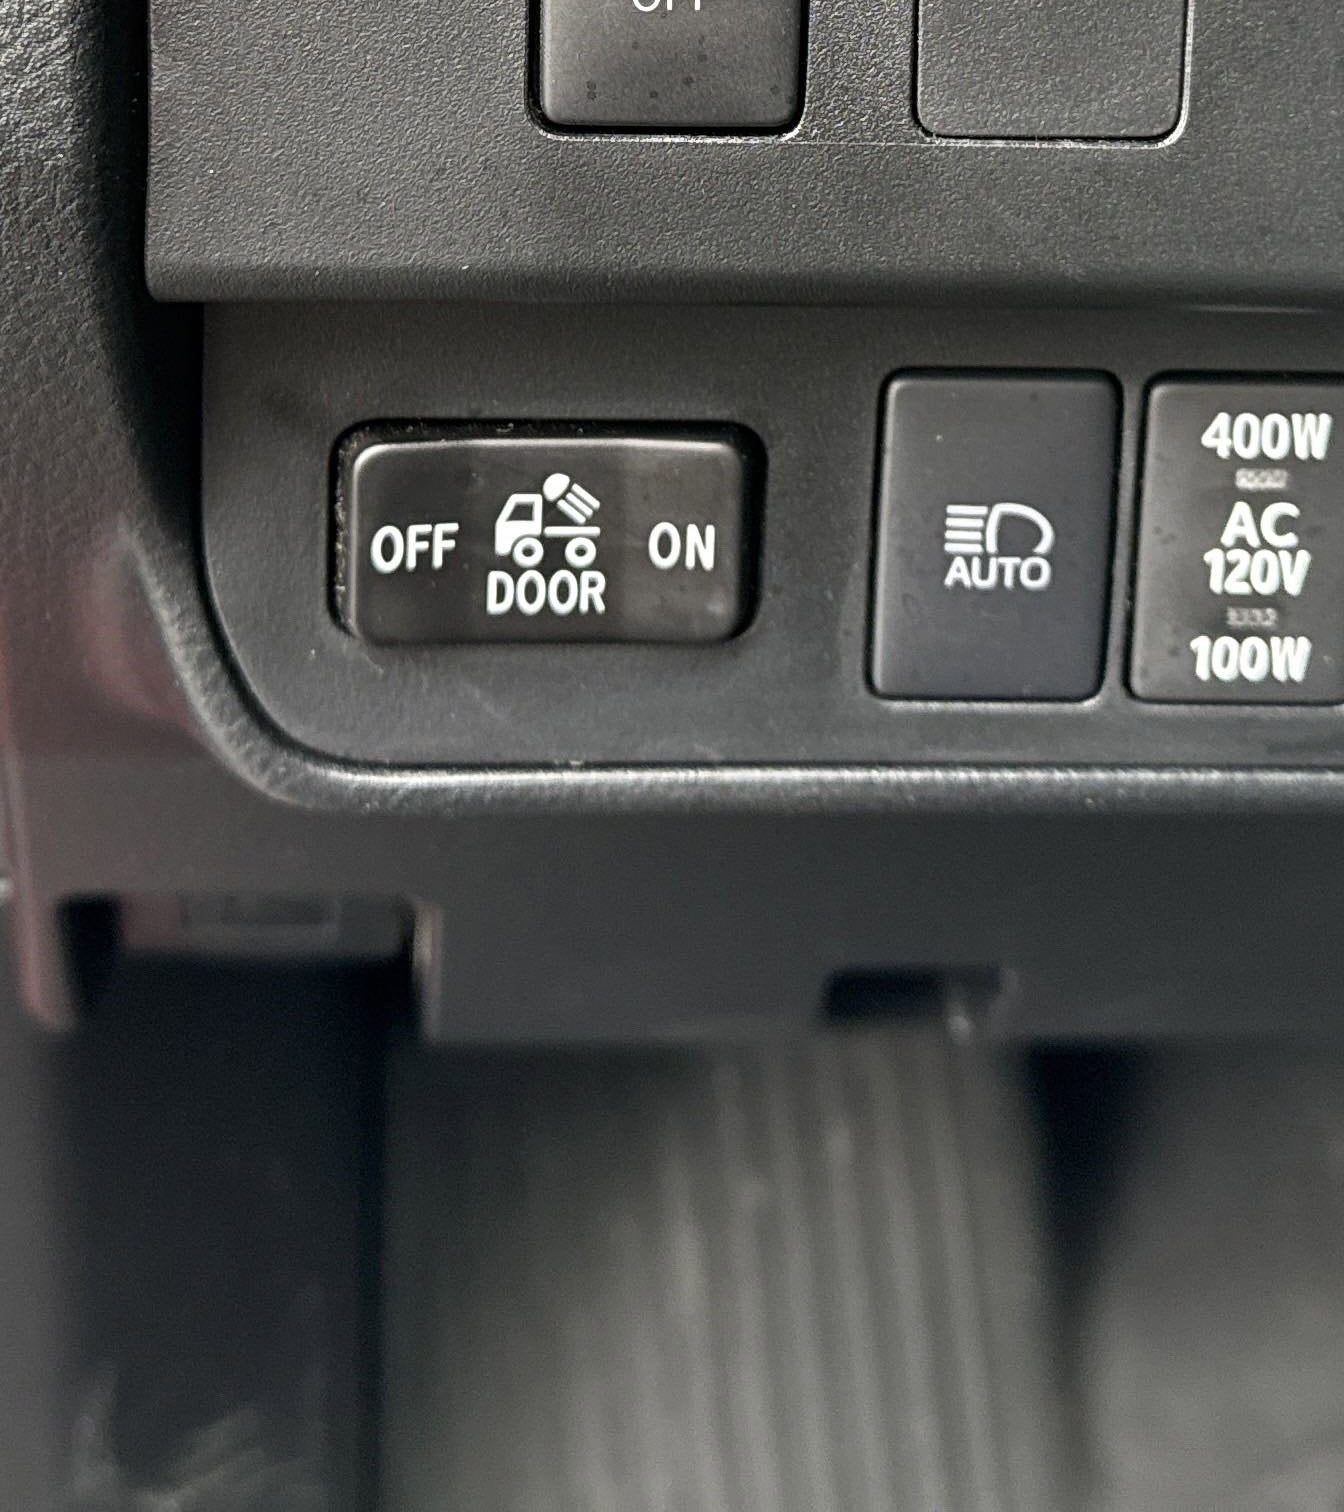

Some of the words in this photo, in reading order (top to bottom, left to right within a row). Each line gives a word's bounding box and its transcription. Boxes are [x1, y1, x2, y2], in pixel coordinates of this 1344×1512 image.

[1200, 410, 1334, 461] 400W
[370, 521, 460, 574] OFF
[647, 521, 717, 571] ON
[1219, 500, 1302, 549] AC
[485, 568, 607, 616] DOOR
[943, 555, 1053, 591] AUTO
[1202, 548, 1313, 597] 120V
[1188, 635, 1314, 683] 100W
